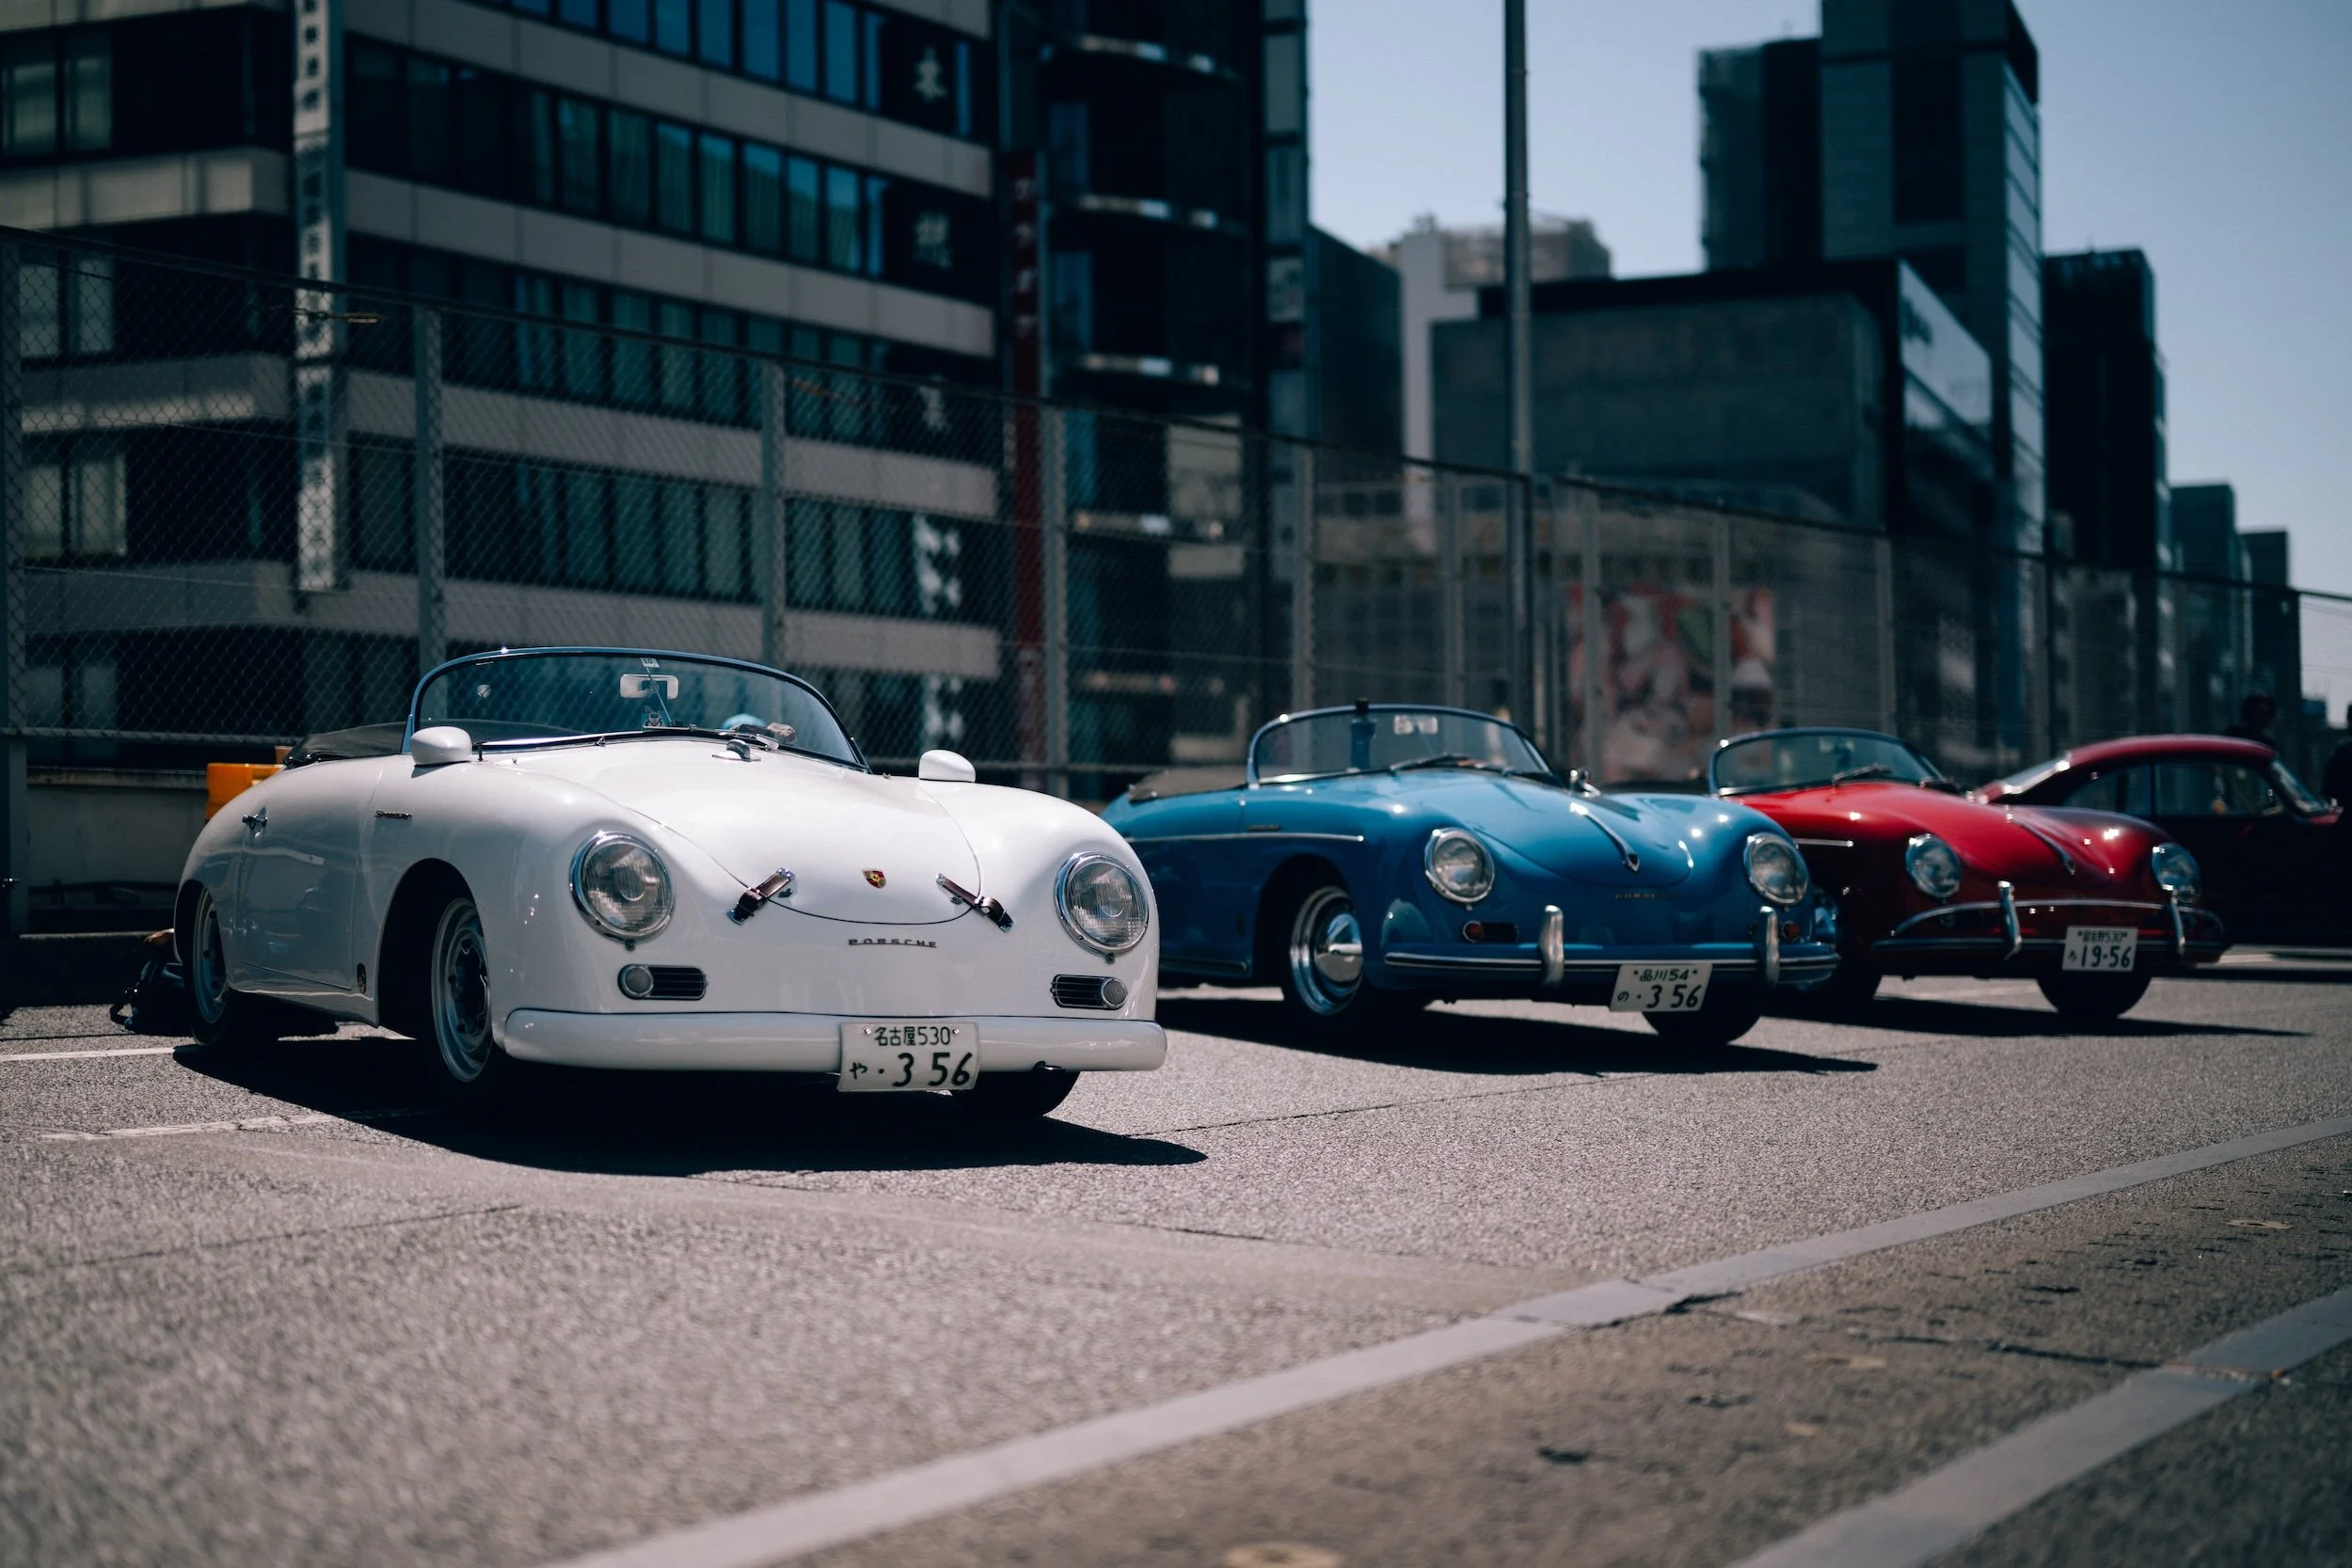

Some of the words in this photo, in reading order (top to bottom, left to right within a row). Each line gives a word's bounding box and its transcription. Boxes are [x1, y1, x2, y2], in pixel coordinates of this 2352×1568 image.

[848, 938, 938, 949] PORSCHE
[1639, 969, 1690, 982] 品川54
[874, 1026, 951, 1047] 名古屋530
